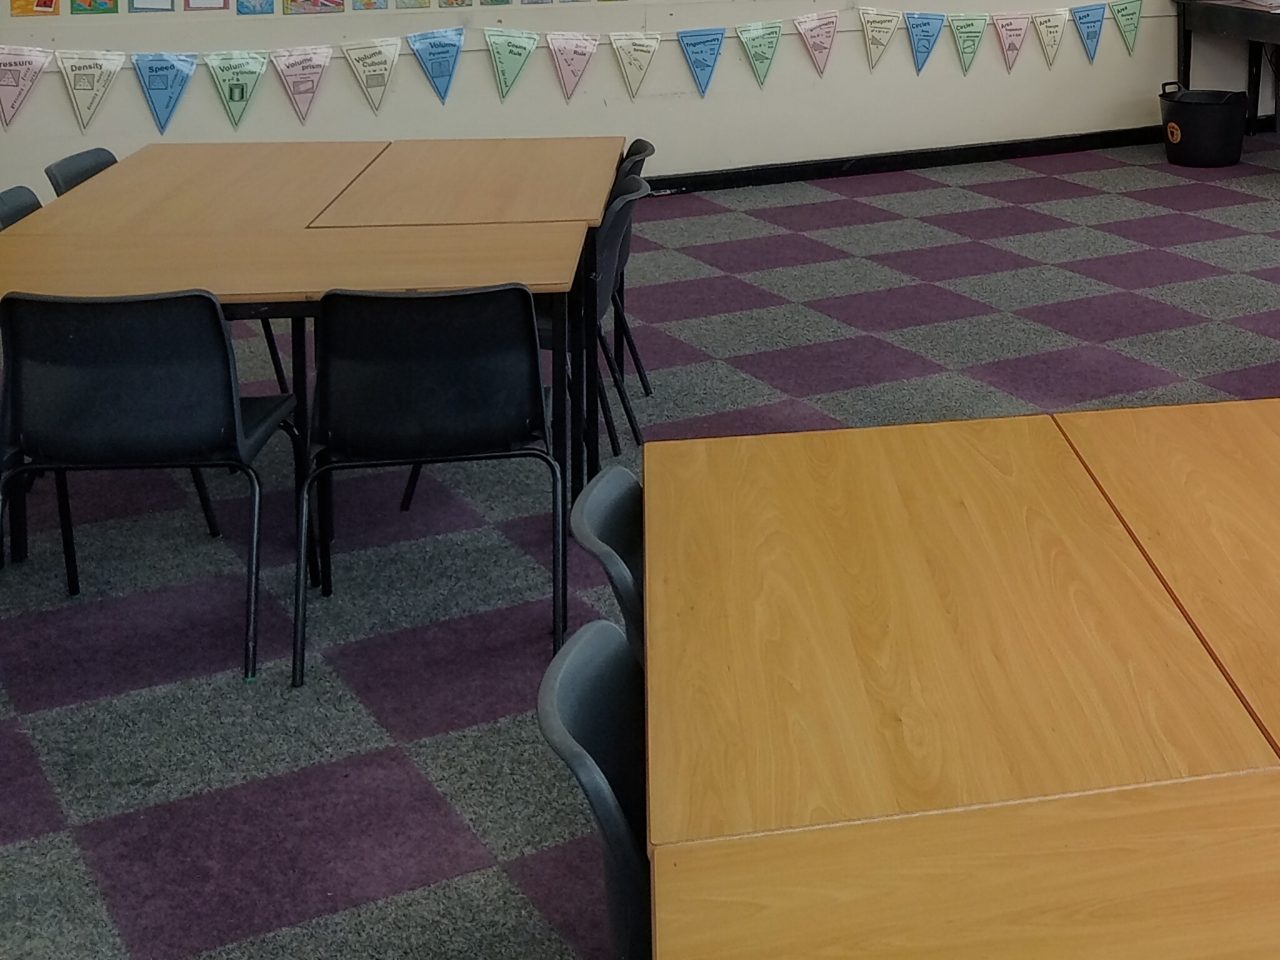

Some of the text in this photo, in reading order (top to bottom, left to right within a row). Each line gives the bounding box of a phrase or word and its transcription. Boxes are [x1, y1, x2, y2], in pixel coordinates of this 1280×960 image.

[1117, 6, 1128, 14] Area
[1078, 13, 1090, 21] Area
[911, 21, 931, 29] Circles
[1001, 21, 1013, 29] Area
[1039, 18, 1051, 26] Area
[956, 22, 975, 31] Circles
[354, 49, 383, 64] Volume
[508, 49, 522, 57] Rule
[284, 56, 313, 69] Volume
[362, 59, 387, 68] Cuboid
[70, 62, 103, 72] Density
[148, 63, 175, 74] Speed
[301, 63, 322, 71] prism
